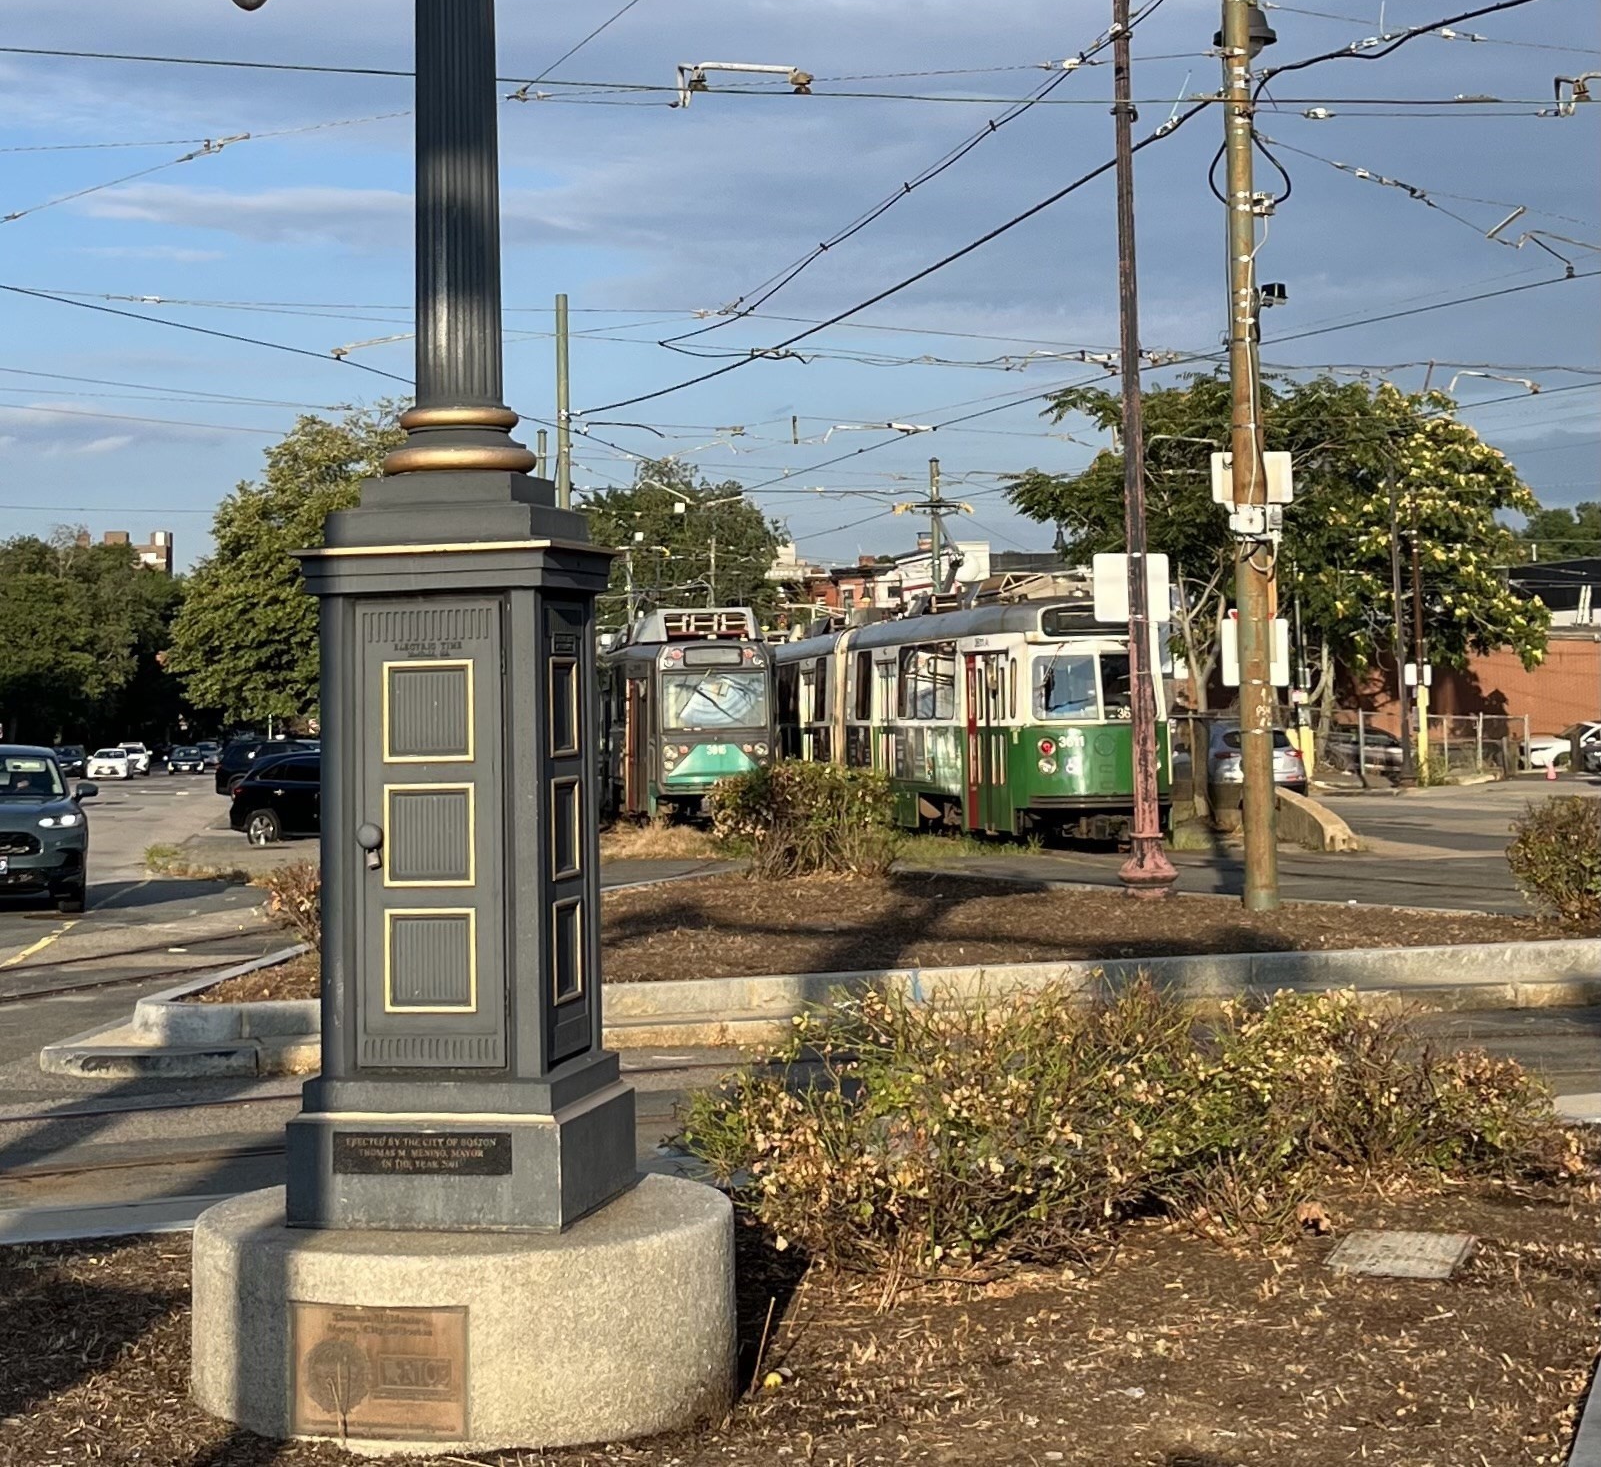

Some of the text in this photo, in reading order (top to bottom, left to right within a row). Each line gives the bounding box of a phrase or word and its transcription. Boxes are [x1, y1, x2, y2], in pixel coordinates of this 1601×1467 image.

[394, 641, 462, 651] ELECTRIC TIME
[346, 1137, 497, 1147] ERECTED BY THE CITY OF BOSTON
[359, 1148, 395, 1157] THOMAS
[451, 1148, 483, 1157] MAYOR
